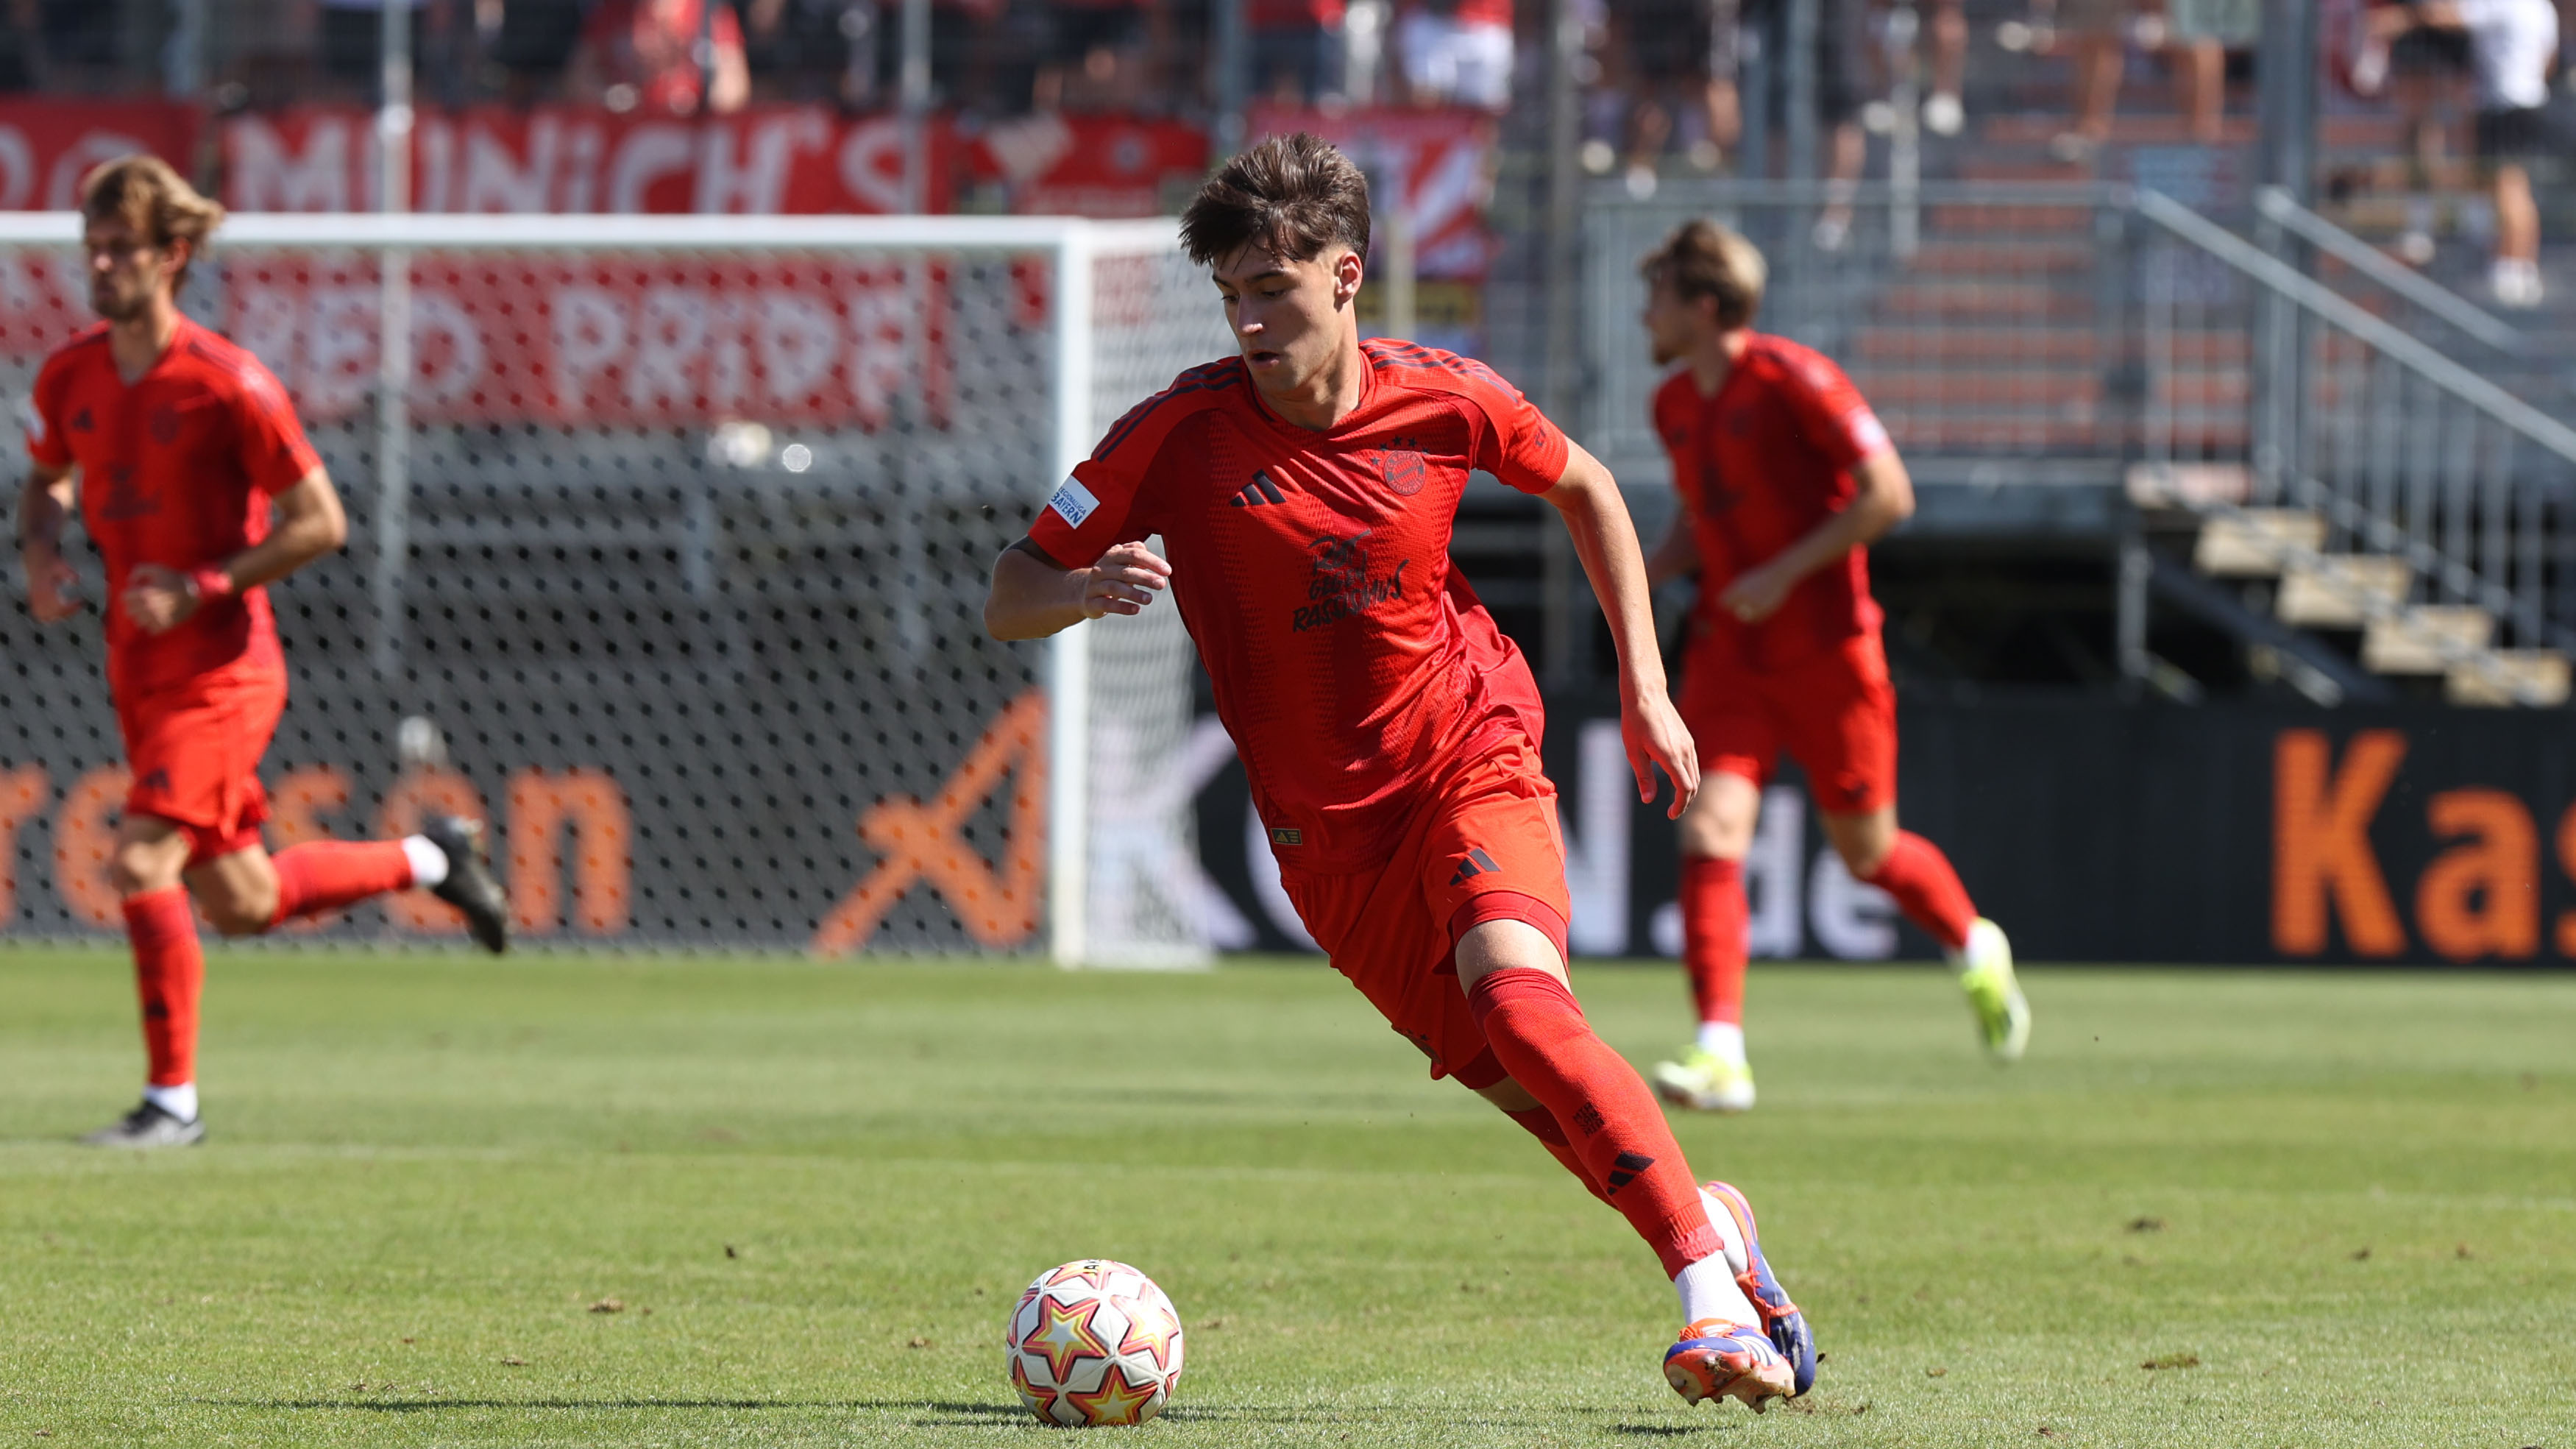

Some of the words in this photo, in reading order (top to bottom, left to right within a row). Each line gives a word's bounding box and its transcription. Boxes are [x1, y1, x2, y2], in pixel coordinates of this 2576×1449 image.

[1051, 492, 1083, 525] BAYERN
[1292, 559, 1410, 634] RASSISMUS
[2271, 727, 2576, 963] Ka
